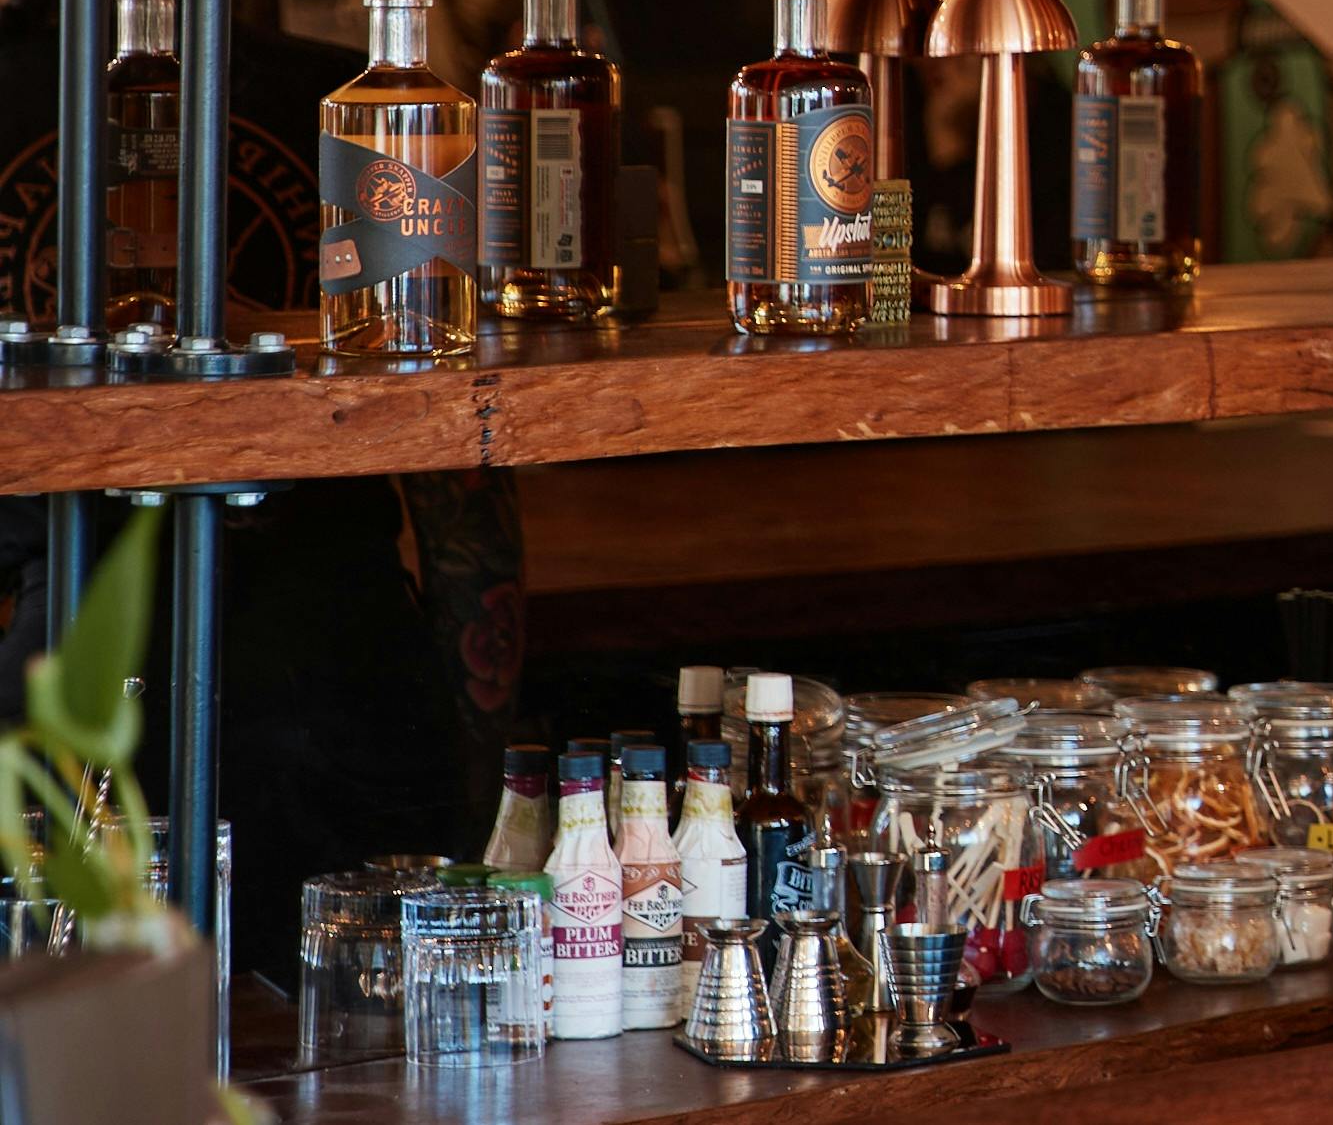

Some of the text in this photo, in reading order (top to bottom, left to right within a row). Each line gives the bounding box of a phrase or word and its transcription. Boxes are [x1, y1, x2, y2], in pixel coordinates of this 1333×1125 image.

[402, 195, 465, 217] CRAZY
[401, 218, 466, 237] UNCLE
[565, 925, 613, 942] PLUM
[556, 939, 620, 958] BITTERS
[625, 948, 682, 965] BITTER
